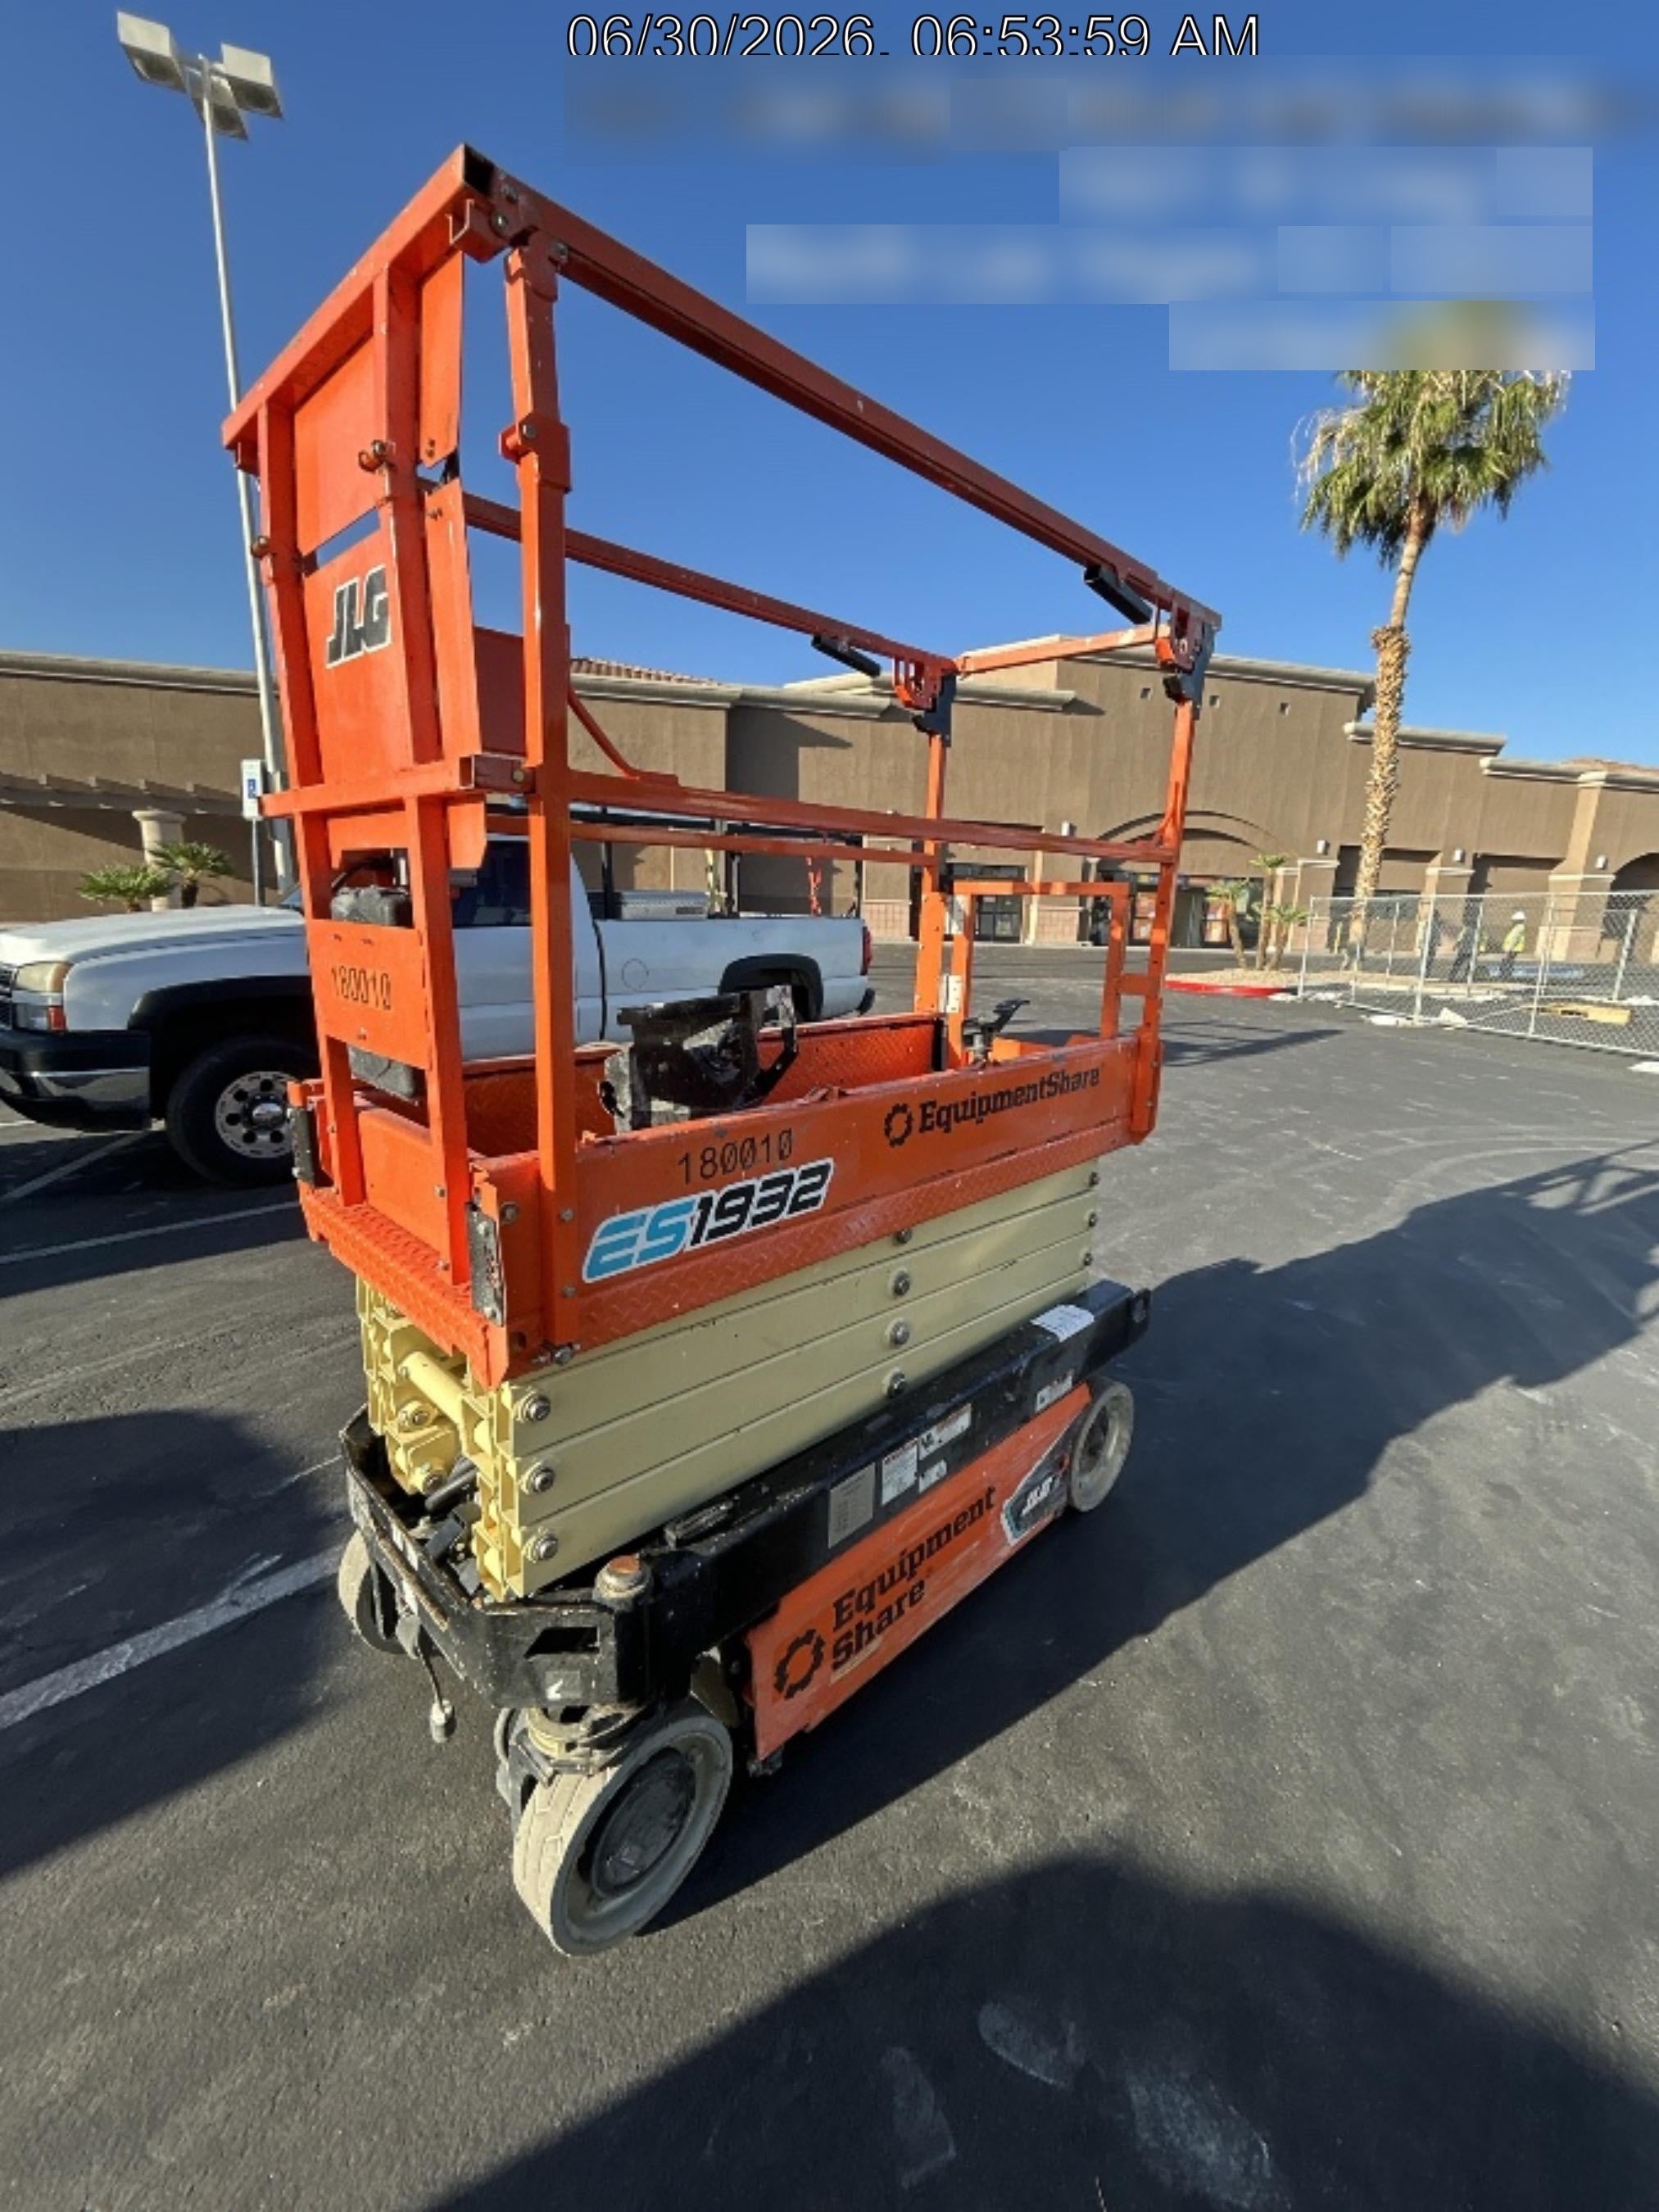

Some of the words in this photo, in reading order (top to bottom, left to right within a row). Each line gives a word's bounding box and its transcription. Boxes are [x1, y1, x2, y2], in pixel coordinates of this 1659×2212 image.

[327, 564, 392, 669] JLG
[331, 965, 392, 1011] 180010
[918, 1067, 1101, 1134] EquipmentShare
[678, 1128, 793, 1185] 180010
[583, 1160, 833, 1281] ES1932
[832, 1485, 996, 1628] Equipment
[832, 1580, 926, 1670] Share
